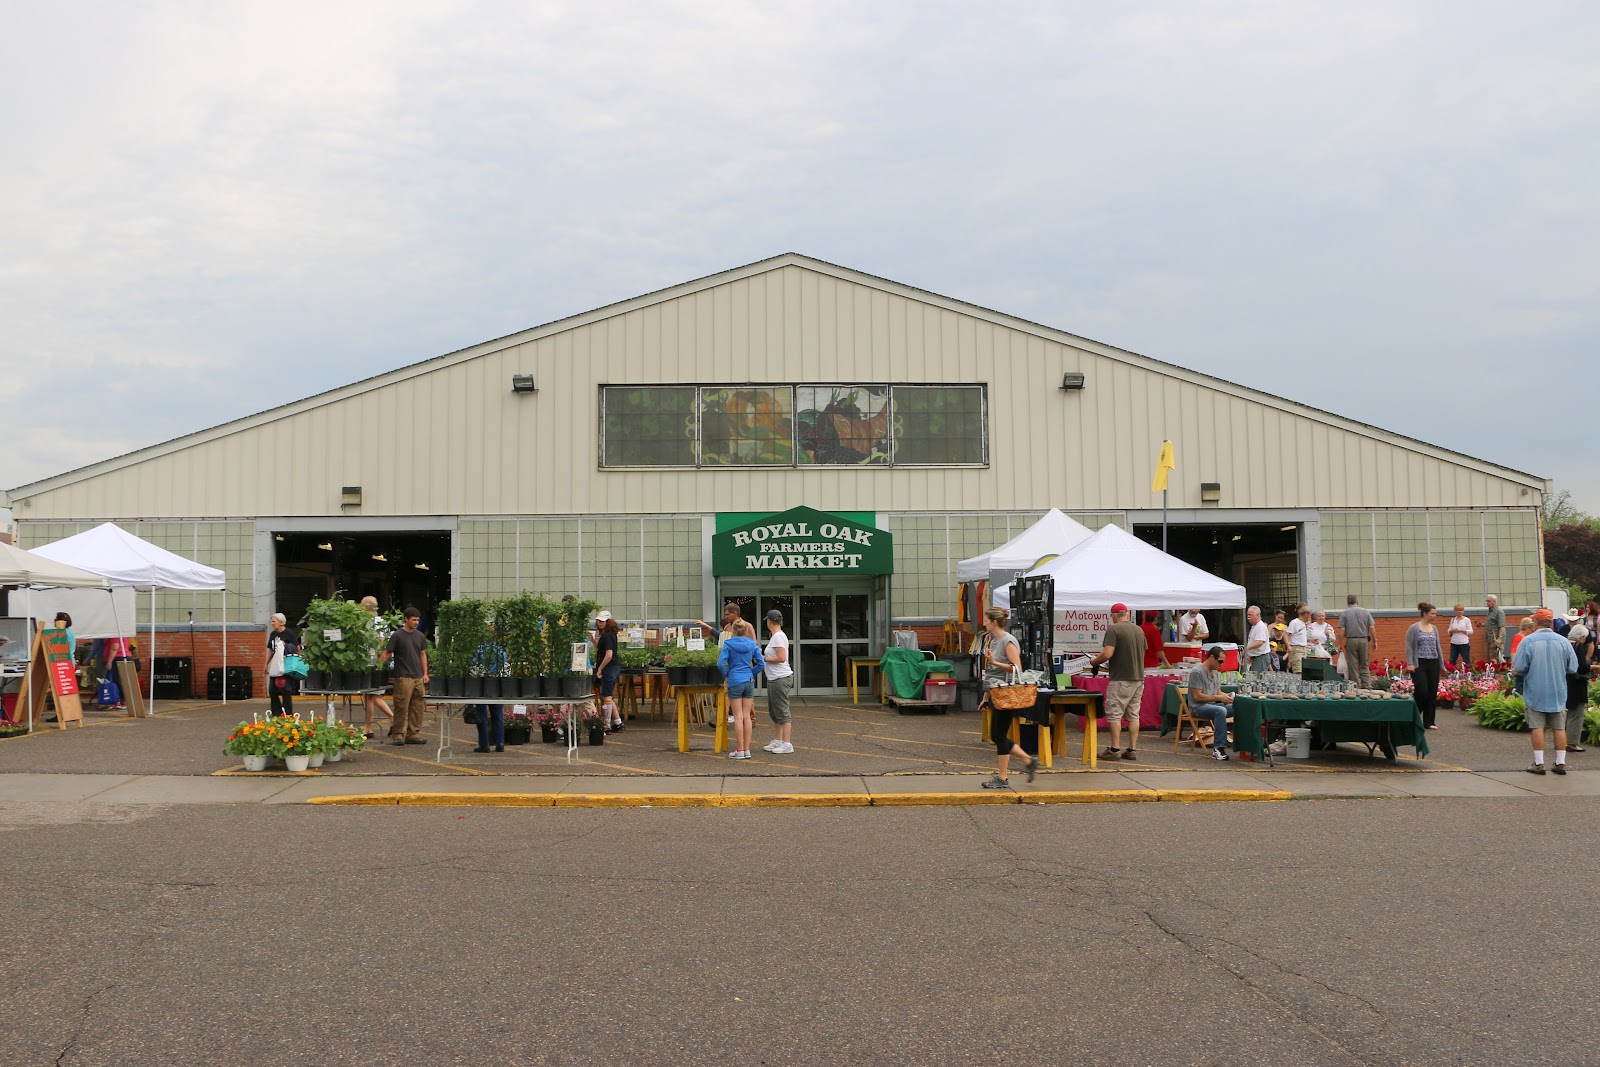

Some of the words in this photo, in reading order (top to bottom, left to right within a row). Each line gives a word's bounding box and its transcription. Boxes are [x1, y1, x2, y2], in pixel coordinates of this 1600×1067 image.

[732, 522, 812, 547] ROYAL
[820, 523, 874, 547] OAK
[760, 542, 845, 553] FARMERS
[745, 554, 862, 569] MARKET
[1065, 610, 1109, 620] Motown
